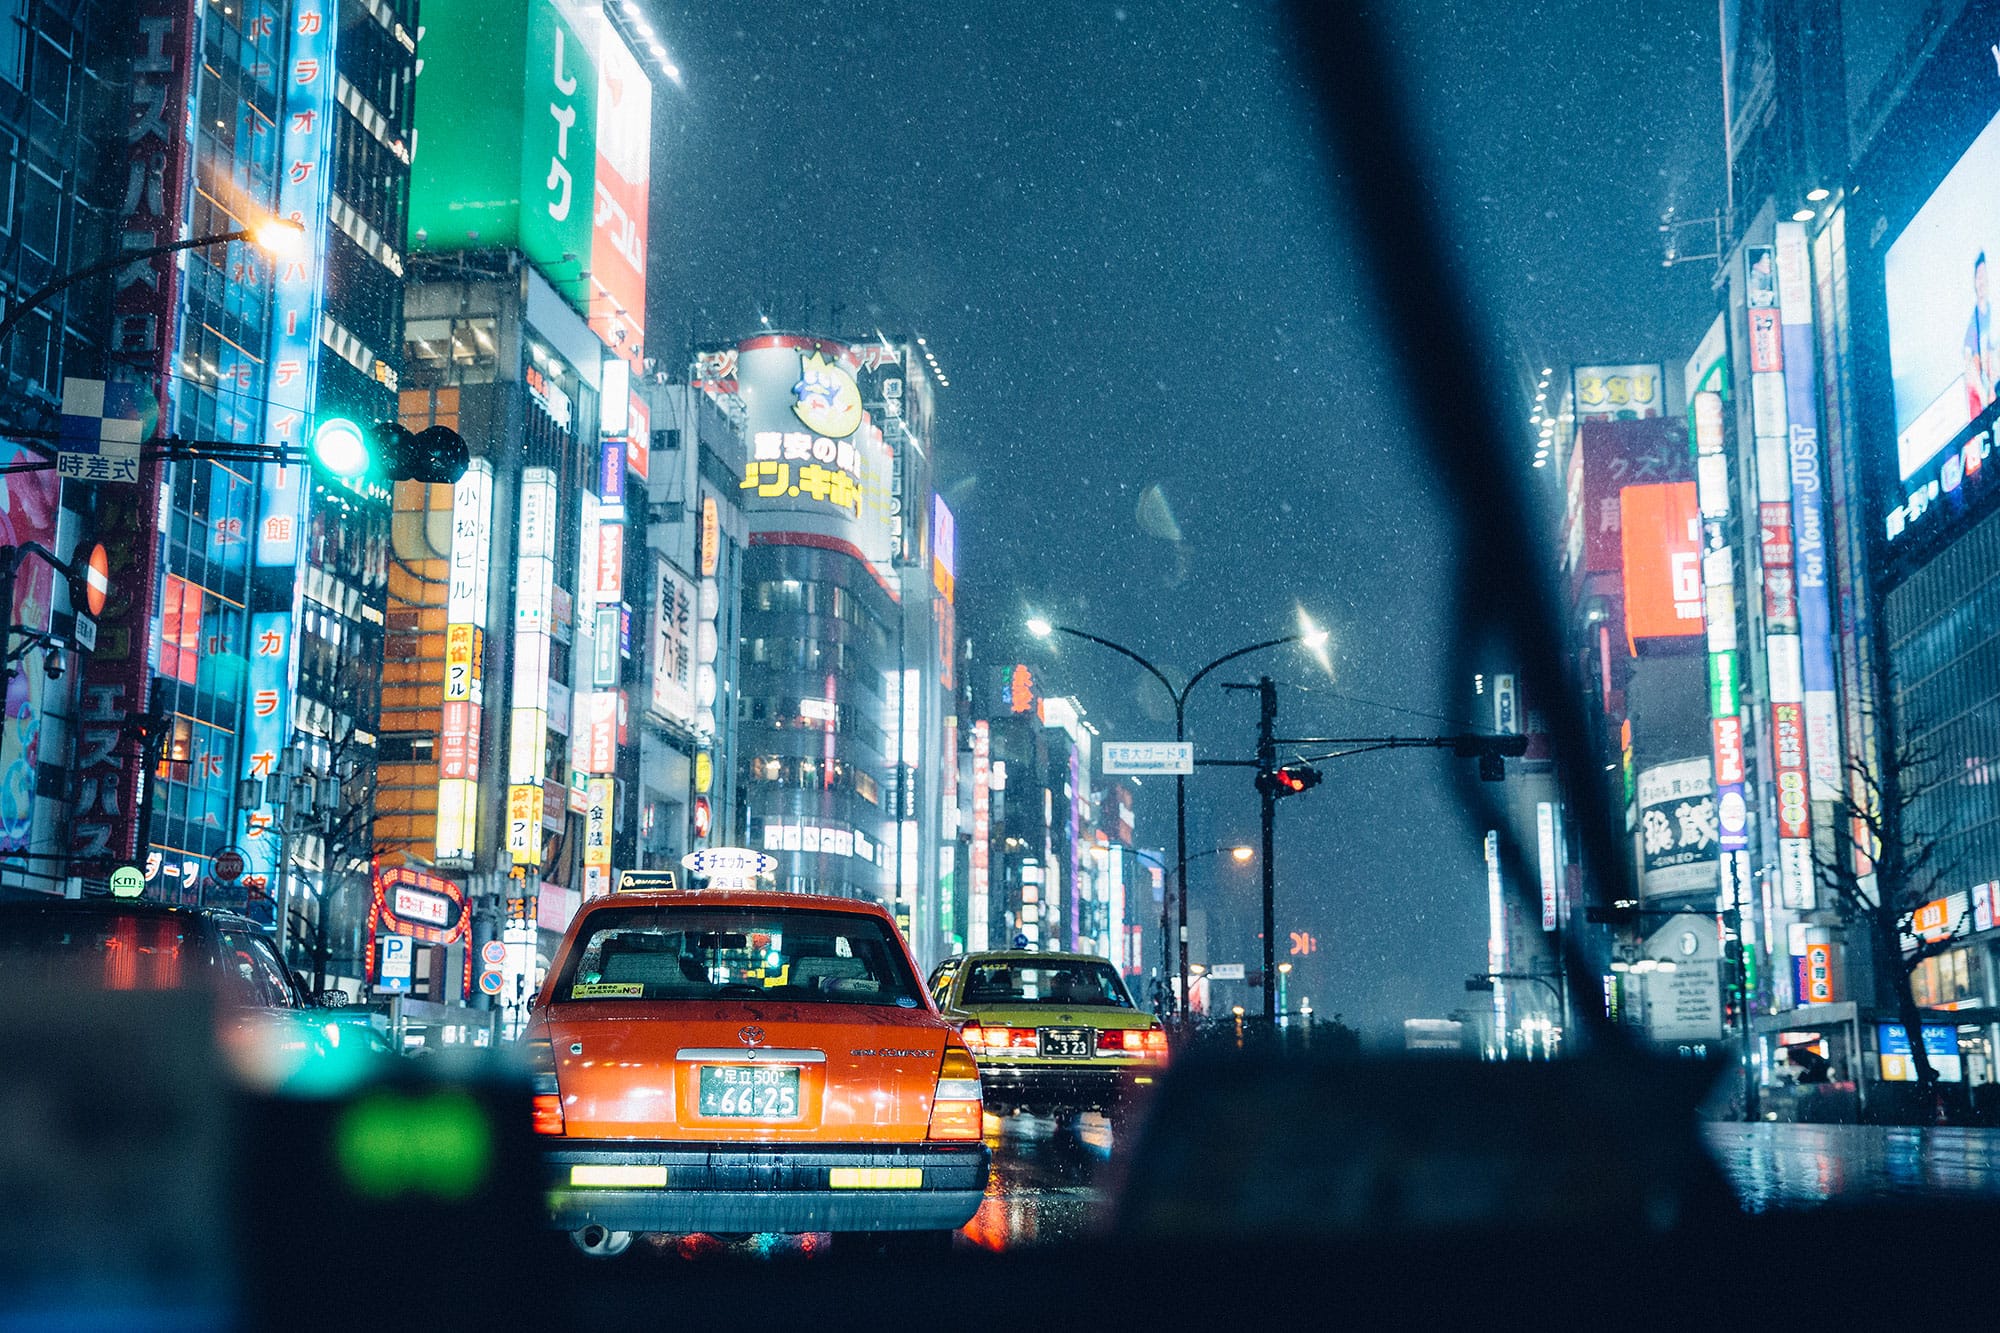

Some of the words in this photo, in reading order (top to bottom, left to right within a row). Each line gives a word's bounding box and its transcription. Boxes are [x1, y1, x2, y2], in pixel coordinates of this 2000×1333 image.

[58, 456, 136, 482] 時差式
[453, 486, 477, 599] 小松ビル
[1802, 553, 1824, 588] For
[1718, 720, 1742, 781] アイフル
[73, 684, 127, 860] エスパス
[708, 853, 752, 869] チェッカー
[387, 940, 403, 959] P
[721, 1086, 796, 1114] 66-25
